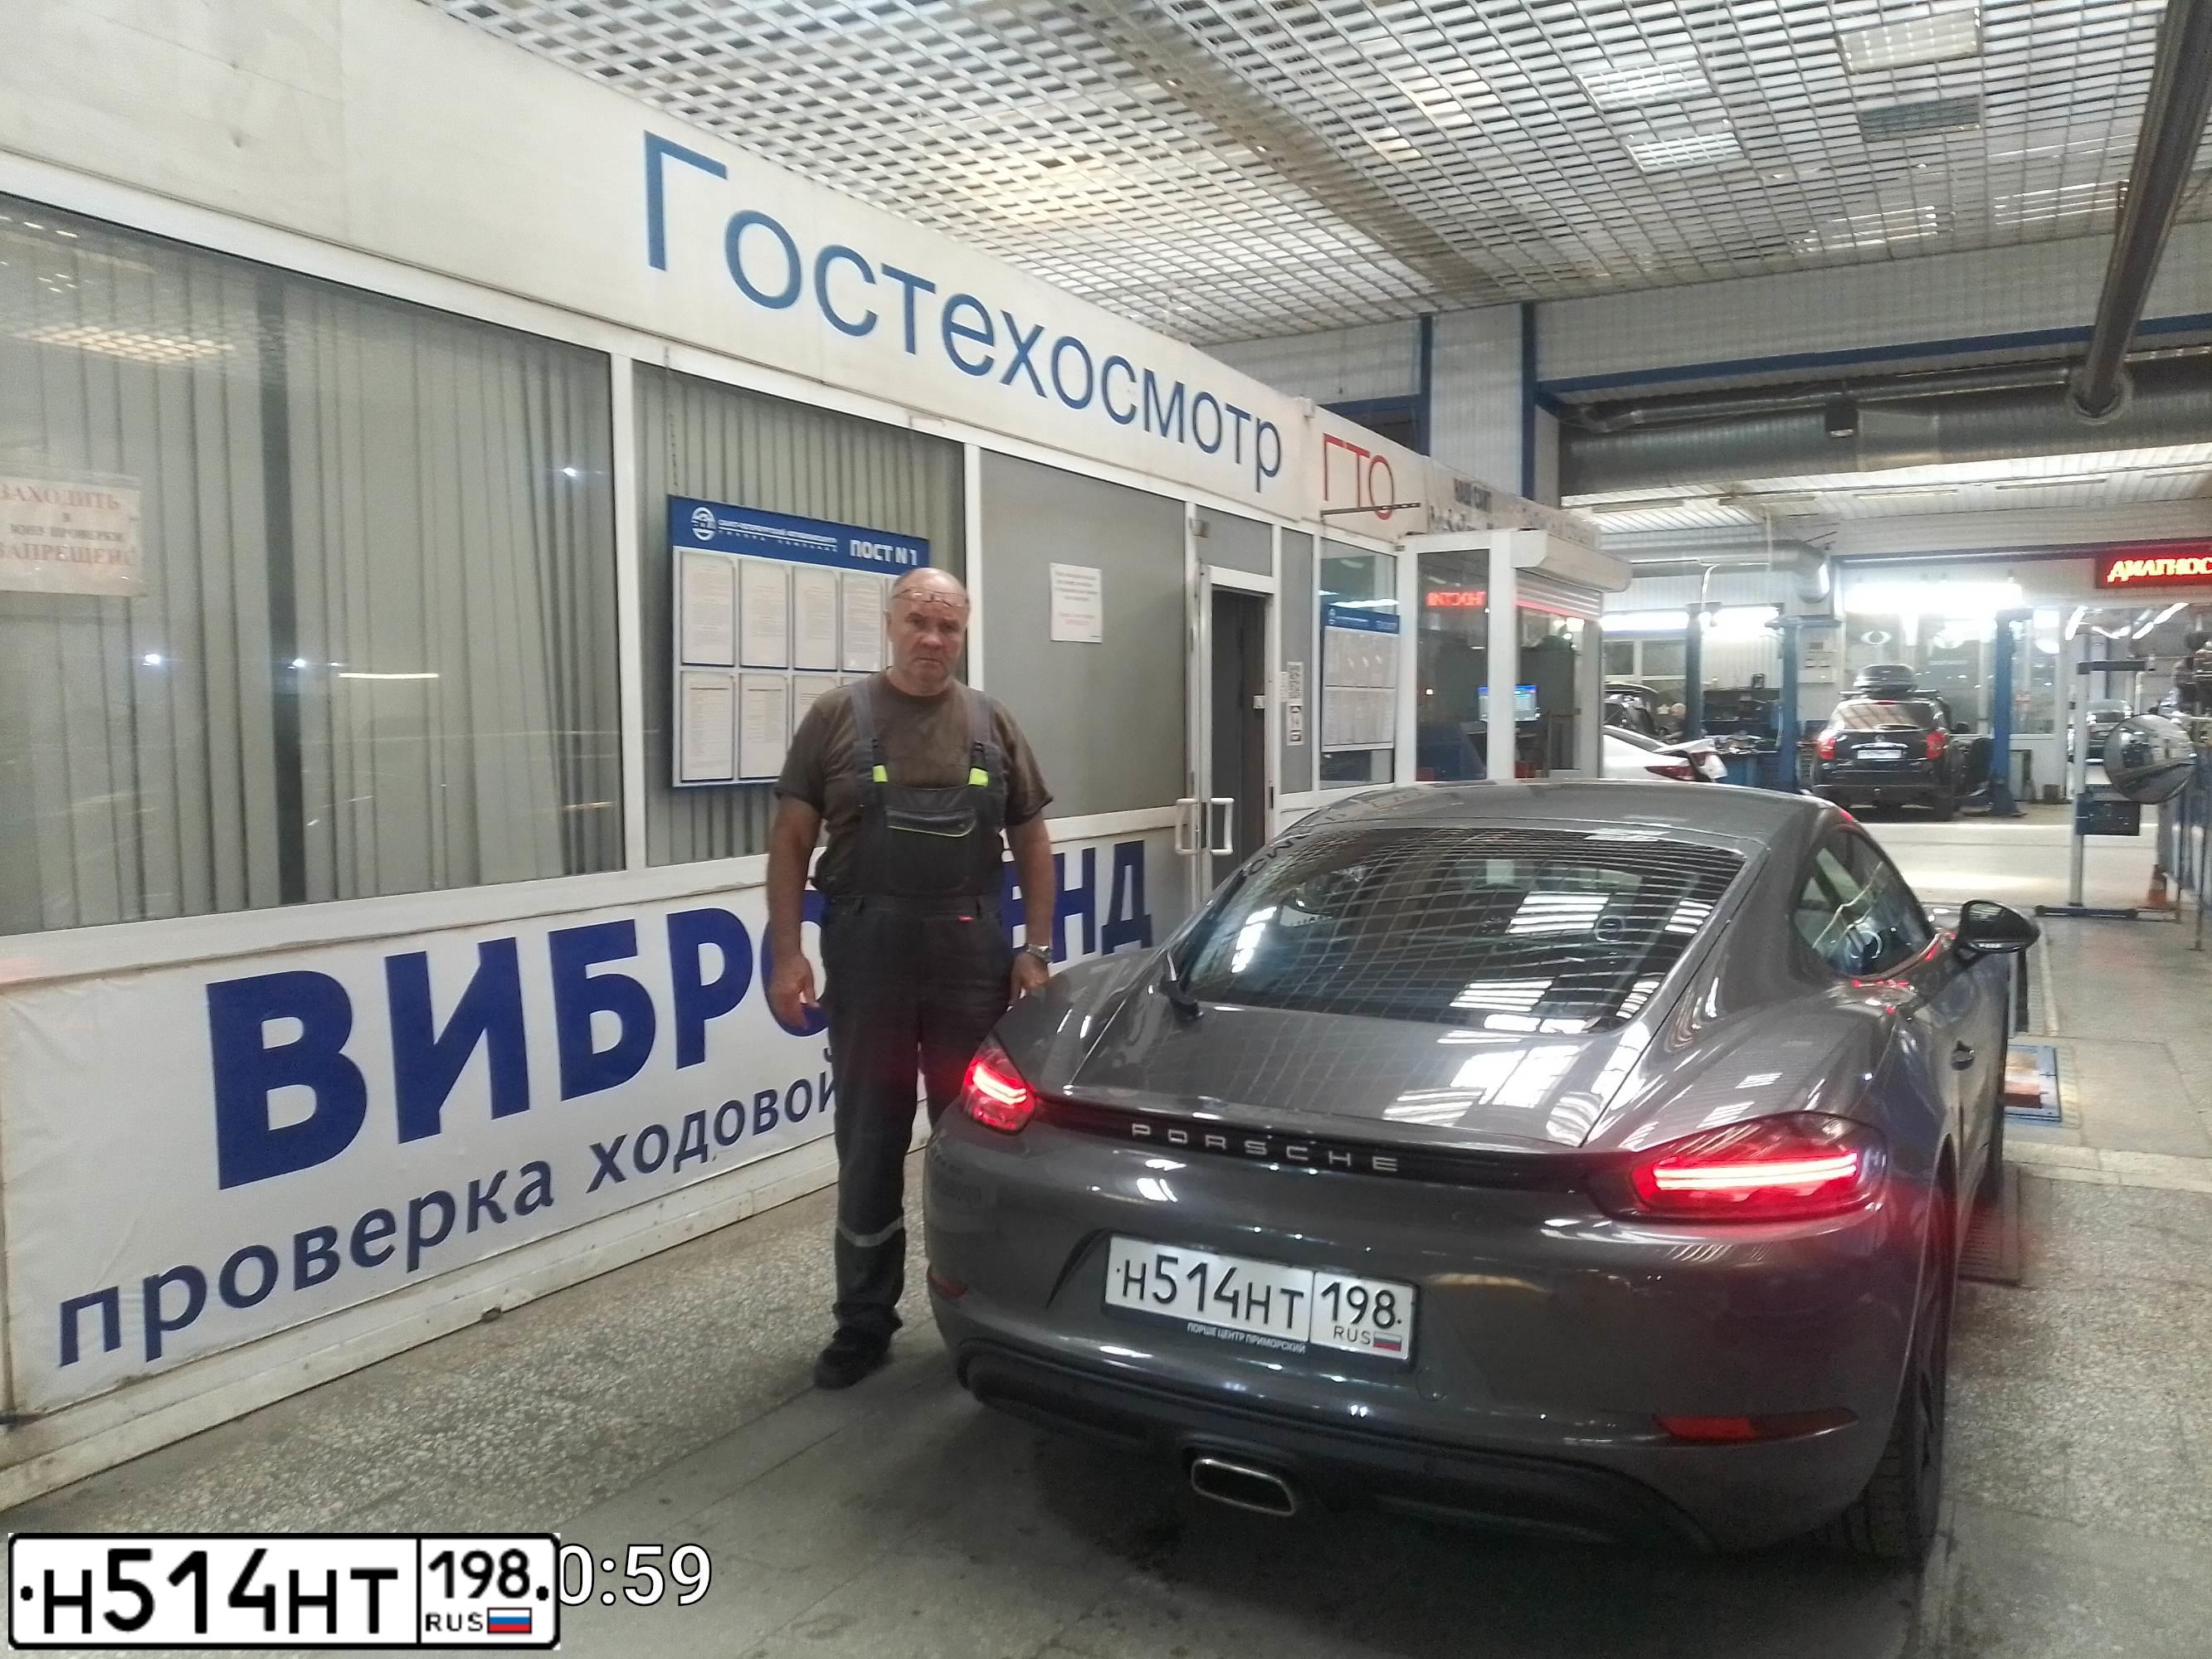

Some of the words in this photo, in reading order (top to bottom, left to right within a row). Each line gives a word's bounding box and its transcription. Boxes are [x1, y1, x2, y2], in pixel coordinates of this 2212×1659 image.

[644, 130, 1281, 493] Гостехосмотр
[1323, 433, 1394, 520] ГТО
[850, 539, 893, 562] ПОСТ
[1131, 1122, 1398, 1173] PORSCHE
[57, 1160, 555, 1368] проверка
[1320, 1282, 1396, 1329] 198
[1186, 1321, 1217, 1338] ПОРШЕ
[1217, 1326, 1245, 1343] ЦЕНТР
[1333, 1326, 1372, 1346] RUS
